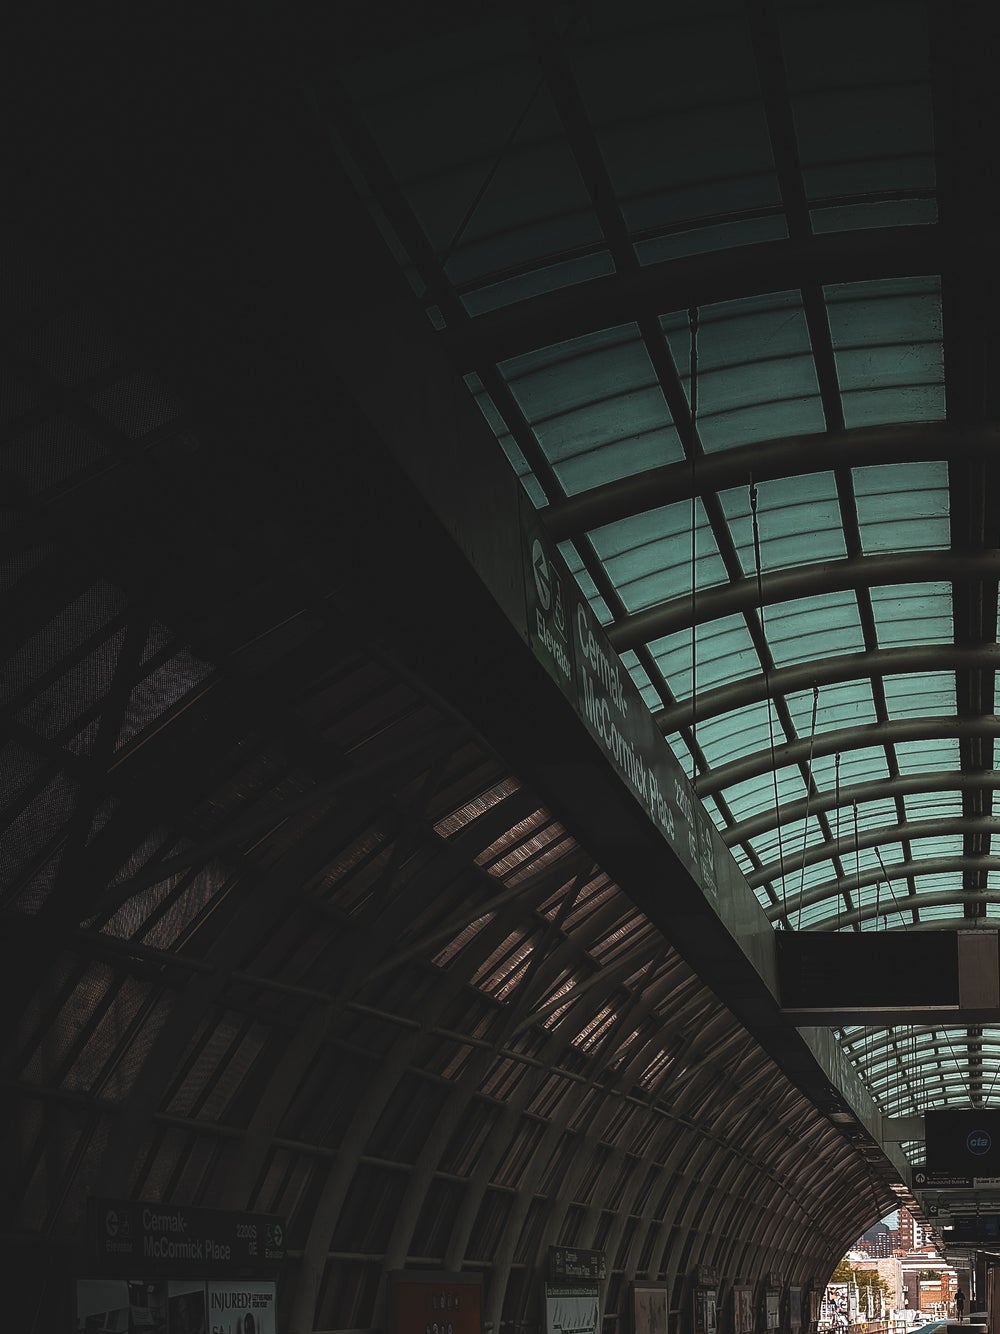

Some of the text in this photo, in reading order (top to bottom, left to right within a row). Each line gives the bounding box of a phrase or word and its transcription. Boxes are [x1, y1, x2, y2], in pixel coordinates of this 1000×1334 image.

[581, 665, 675, 841] McCormick Place
[970, 1137, 988, 1147] cta
[143, 1236, 203, 1260] McCormick
[205, 1239, 231, 1260] Place
[211, 1292, 251, 1312] INJURED?
